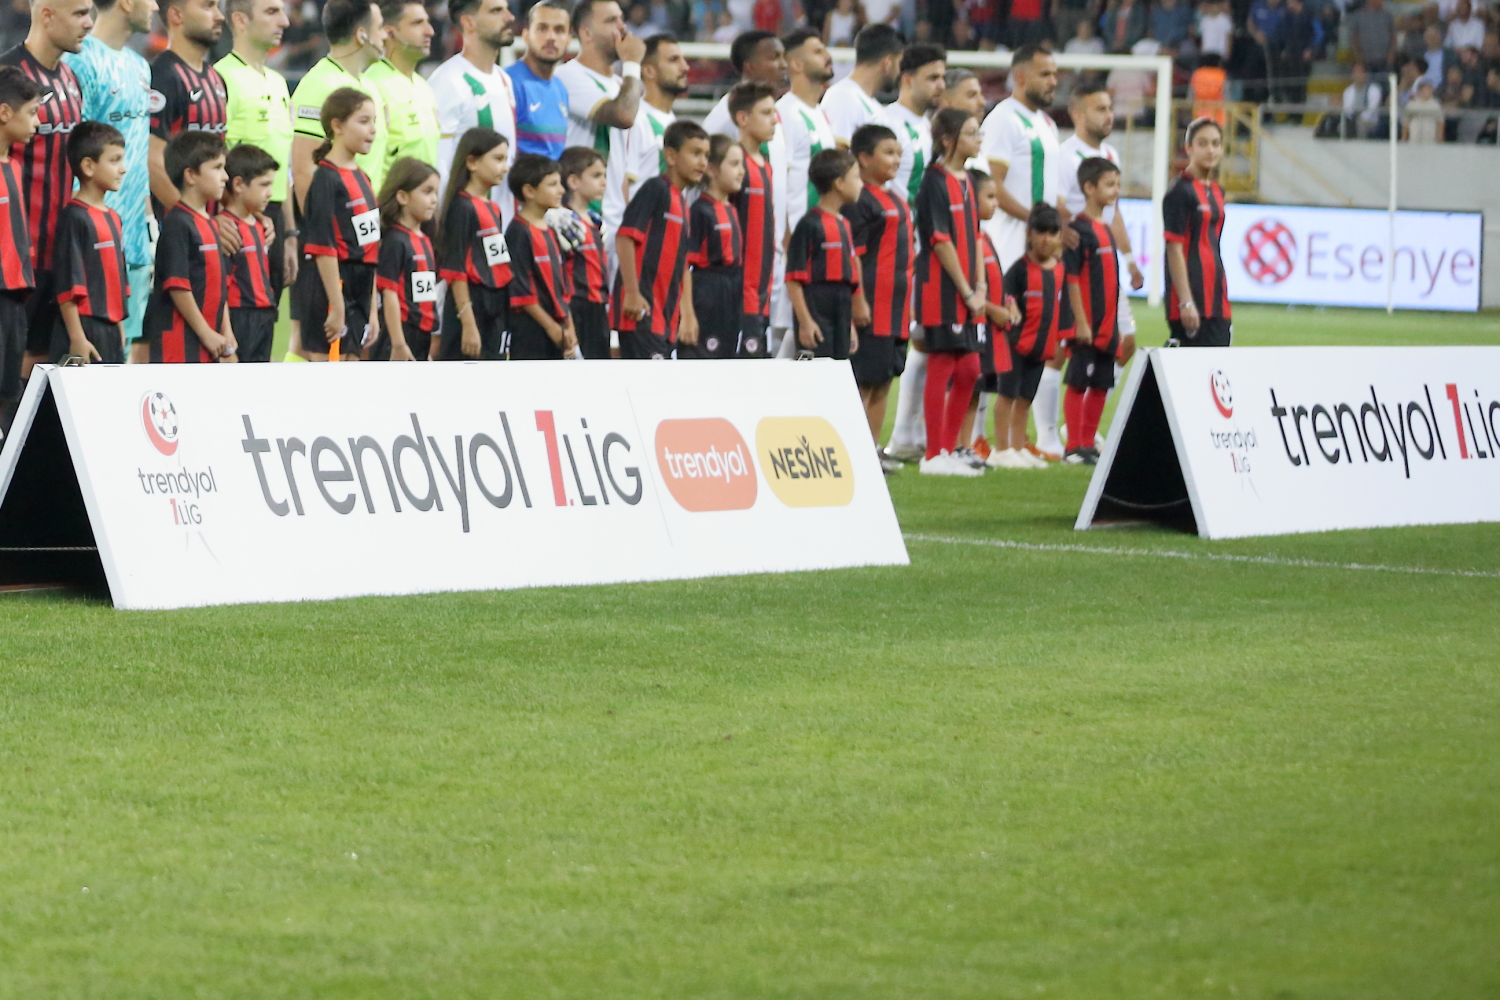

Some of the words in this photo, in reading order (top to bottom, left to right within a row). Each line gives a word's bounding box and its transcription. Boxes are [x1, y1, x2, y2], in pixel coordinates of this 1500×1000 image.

[359, 221, 379, 236] SA
[1306, 231, 1474, 298] Esenye
[416, 279, 435, 293] SA
[1210, 427, 1259, 452] trendyol
[1270, 384, 1447, 479] trendyol
[242, 412, 533, 533] trendyol
[664, 443, 749, 483] trendyol
[138, 465, 218, 499] trendyol
